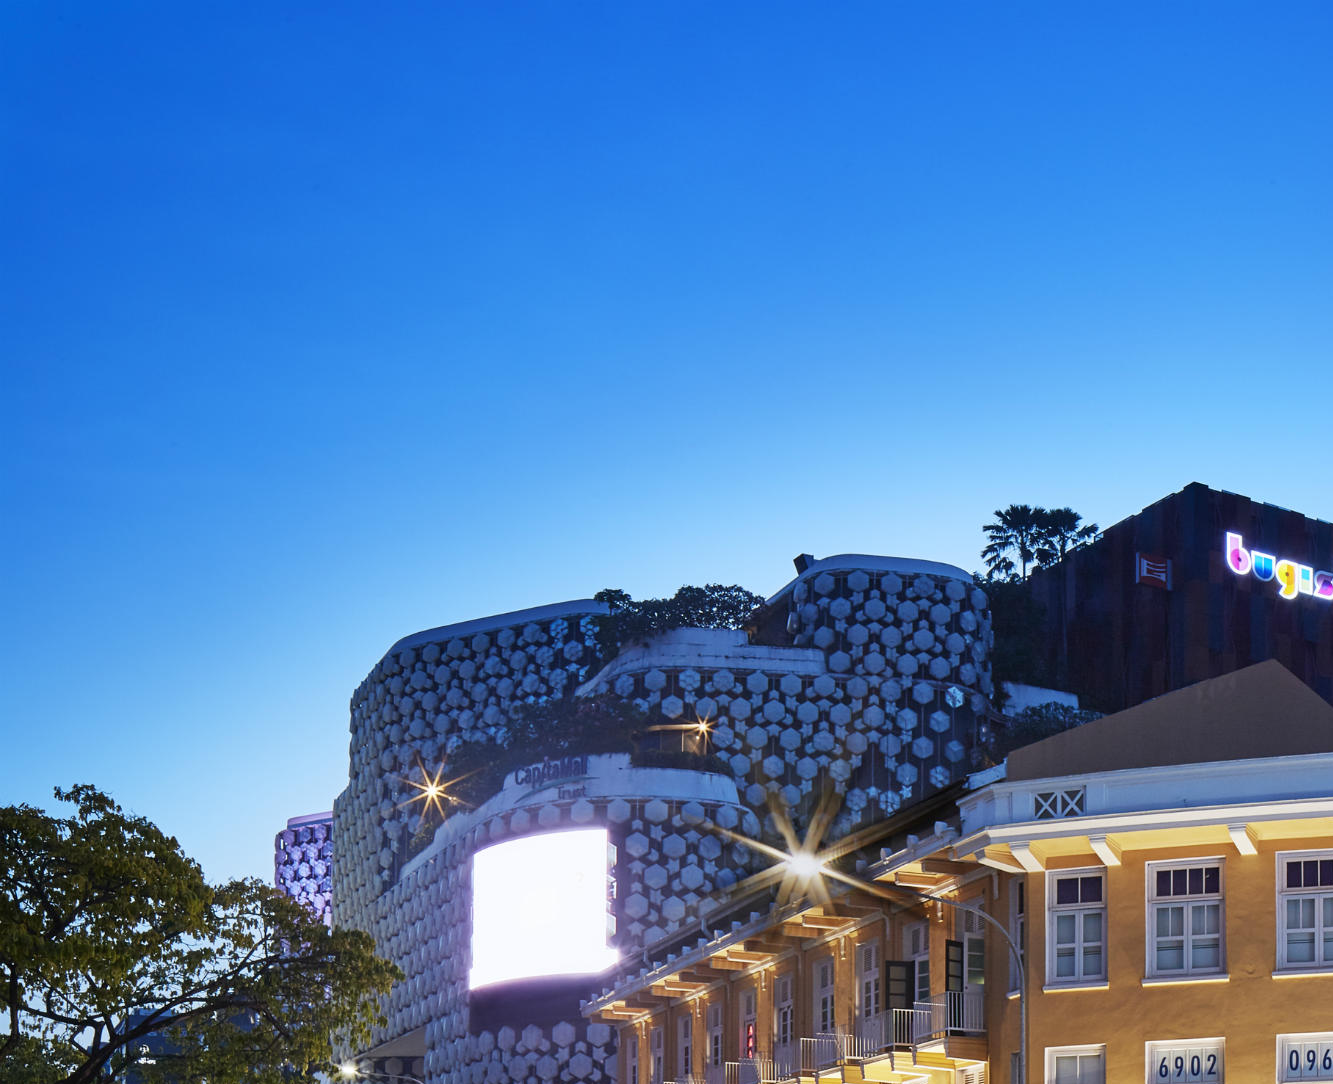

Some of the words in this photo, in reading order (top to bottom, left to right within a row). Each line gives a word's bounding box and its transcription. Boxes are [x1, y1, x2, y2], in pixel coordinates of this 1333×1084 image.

[515, 756, 588, 788] CapitaMall
[558, 784, 586, 800] Trust
[1159, 1054, 1217, 1078] 6902
